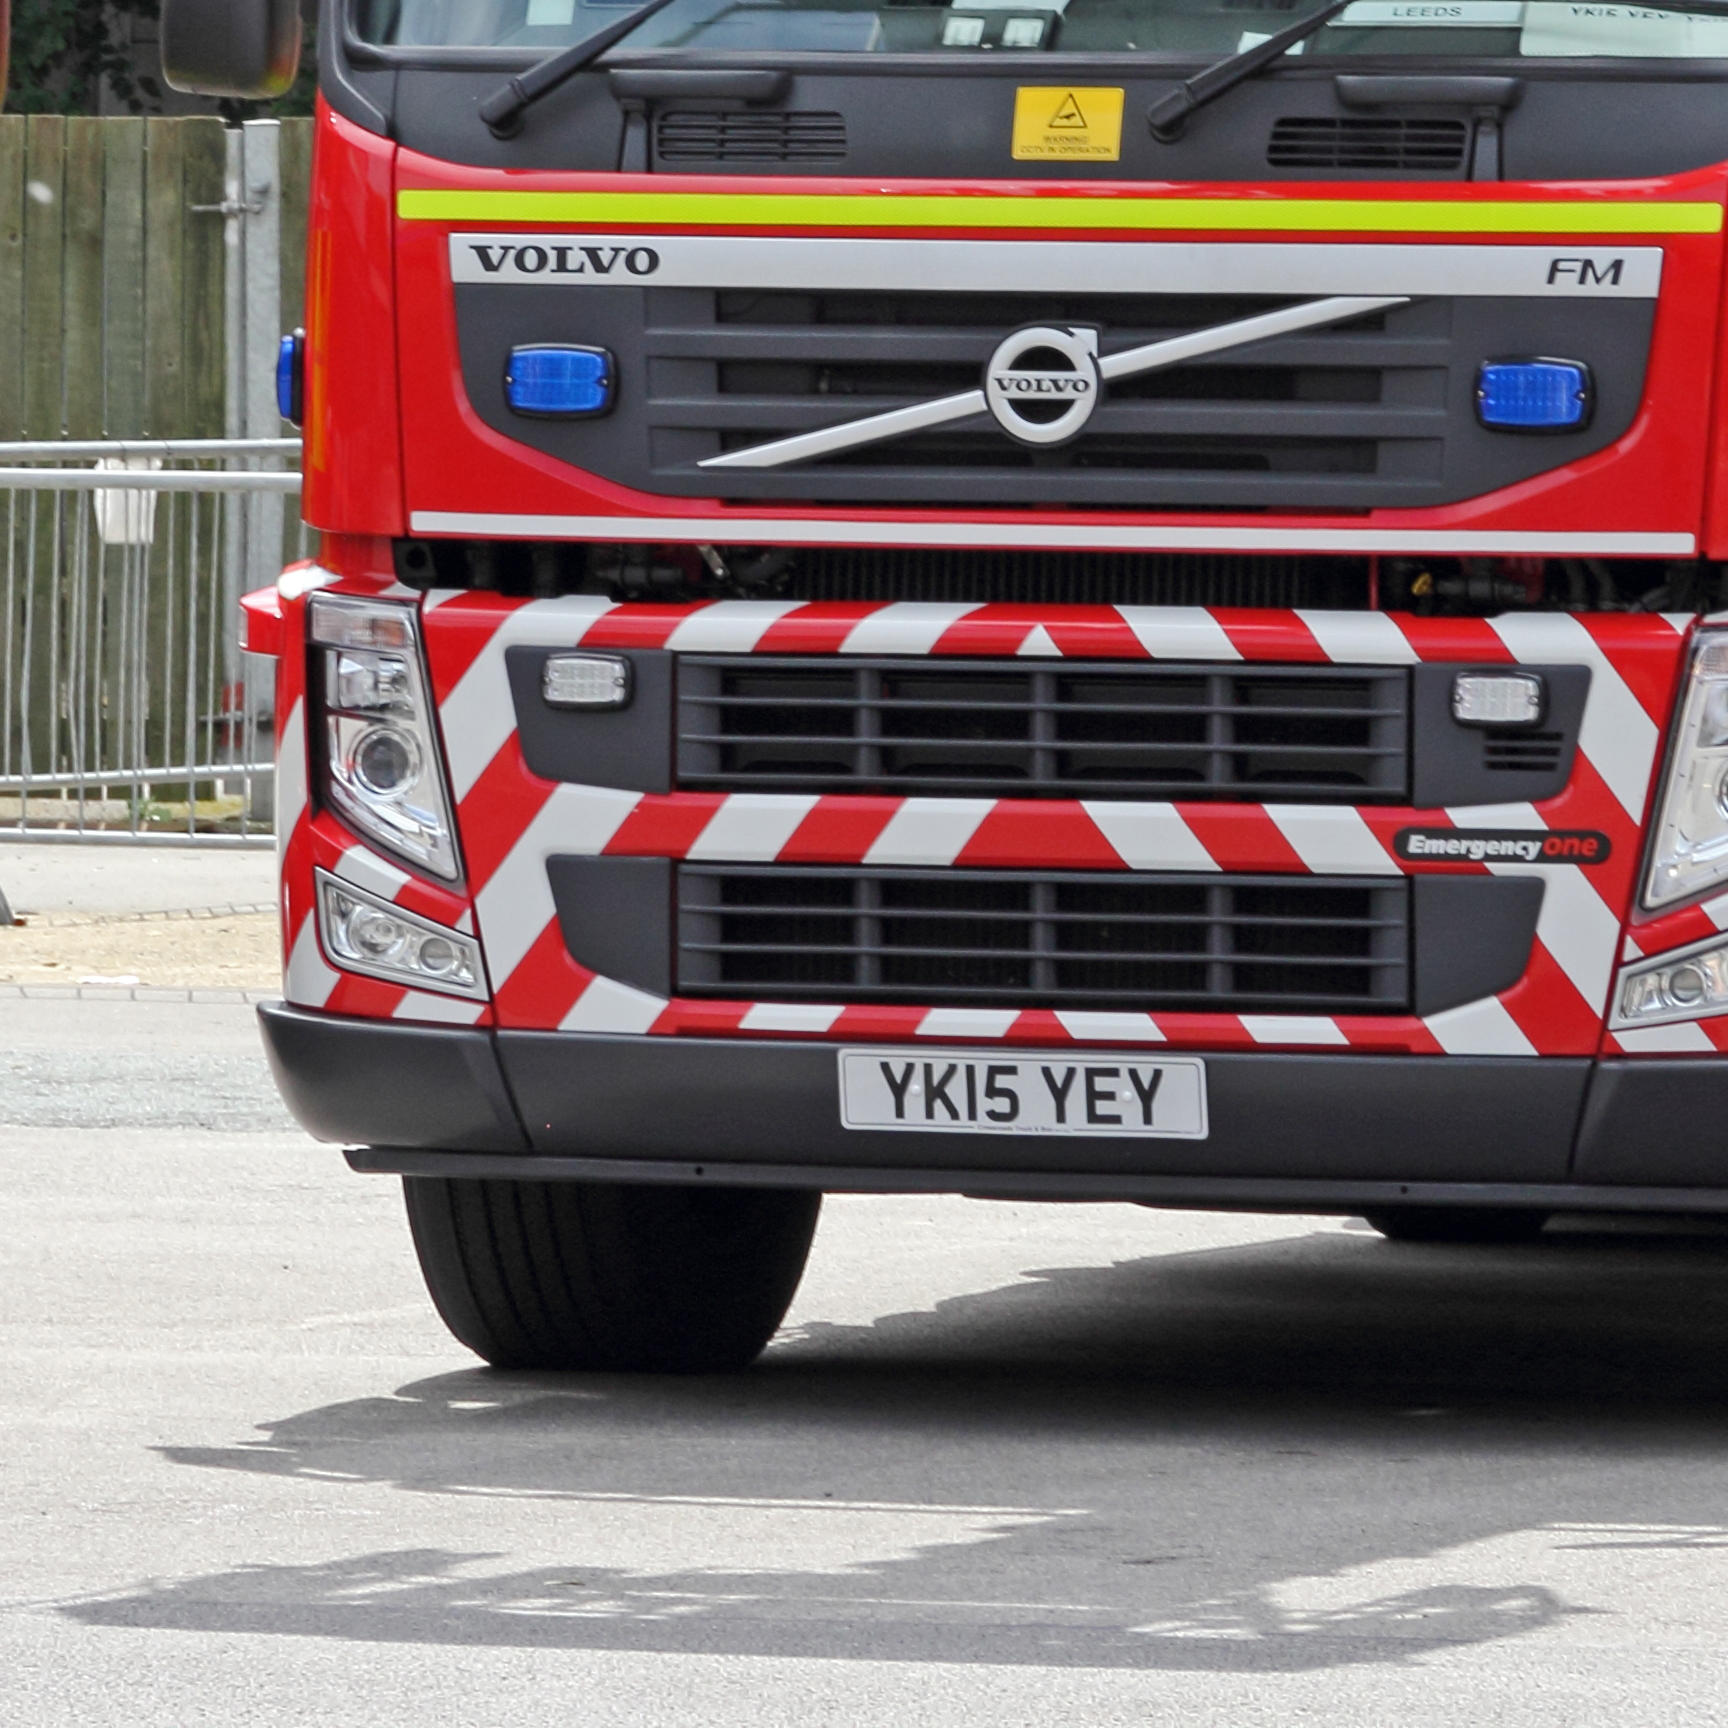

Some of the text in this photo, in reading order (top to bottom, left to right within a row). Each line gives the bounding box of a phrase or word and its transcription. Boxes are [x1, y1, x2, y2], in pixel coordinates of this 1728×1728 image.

[1392, 6, 1462, 17] LEEDS
[468, 244, 660, 276] VOLVO
[1546, 258, 1625, 286] FM
[993, 377, 1091, 394] VOLVO
[880, 1061, 1164, 1126] YK15 YEY
